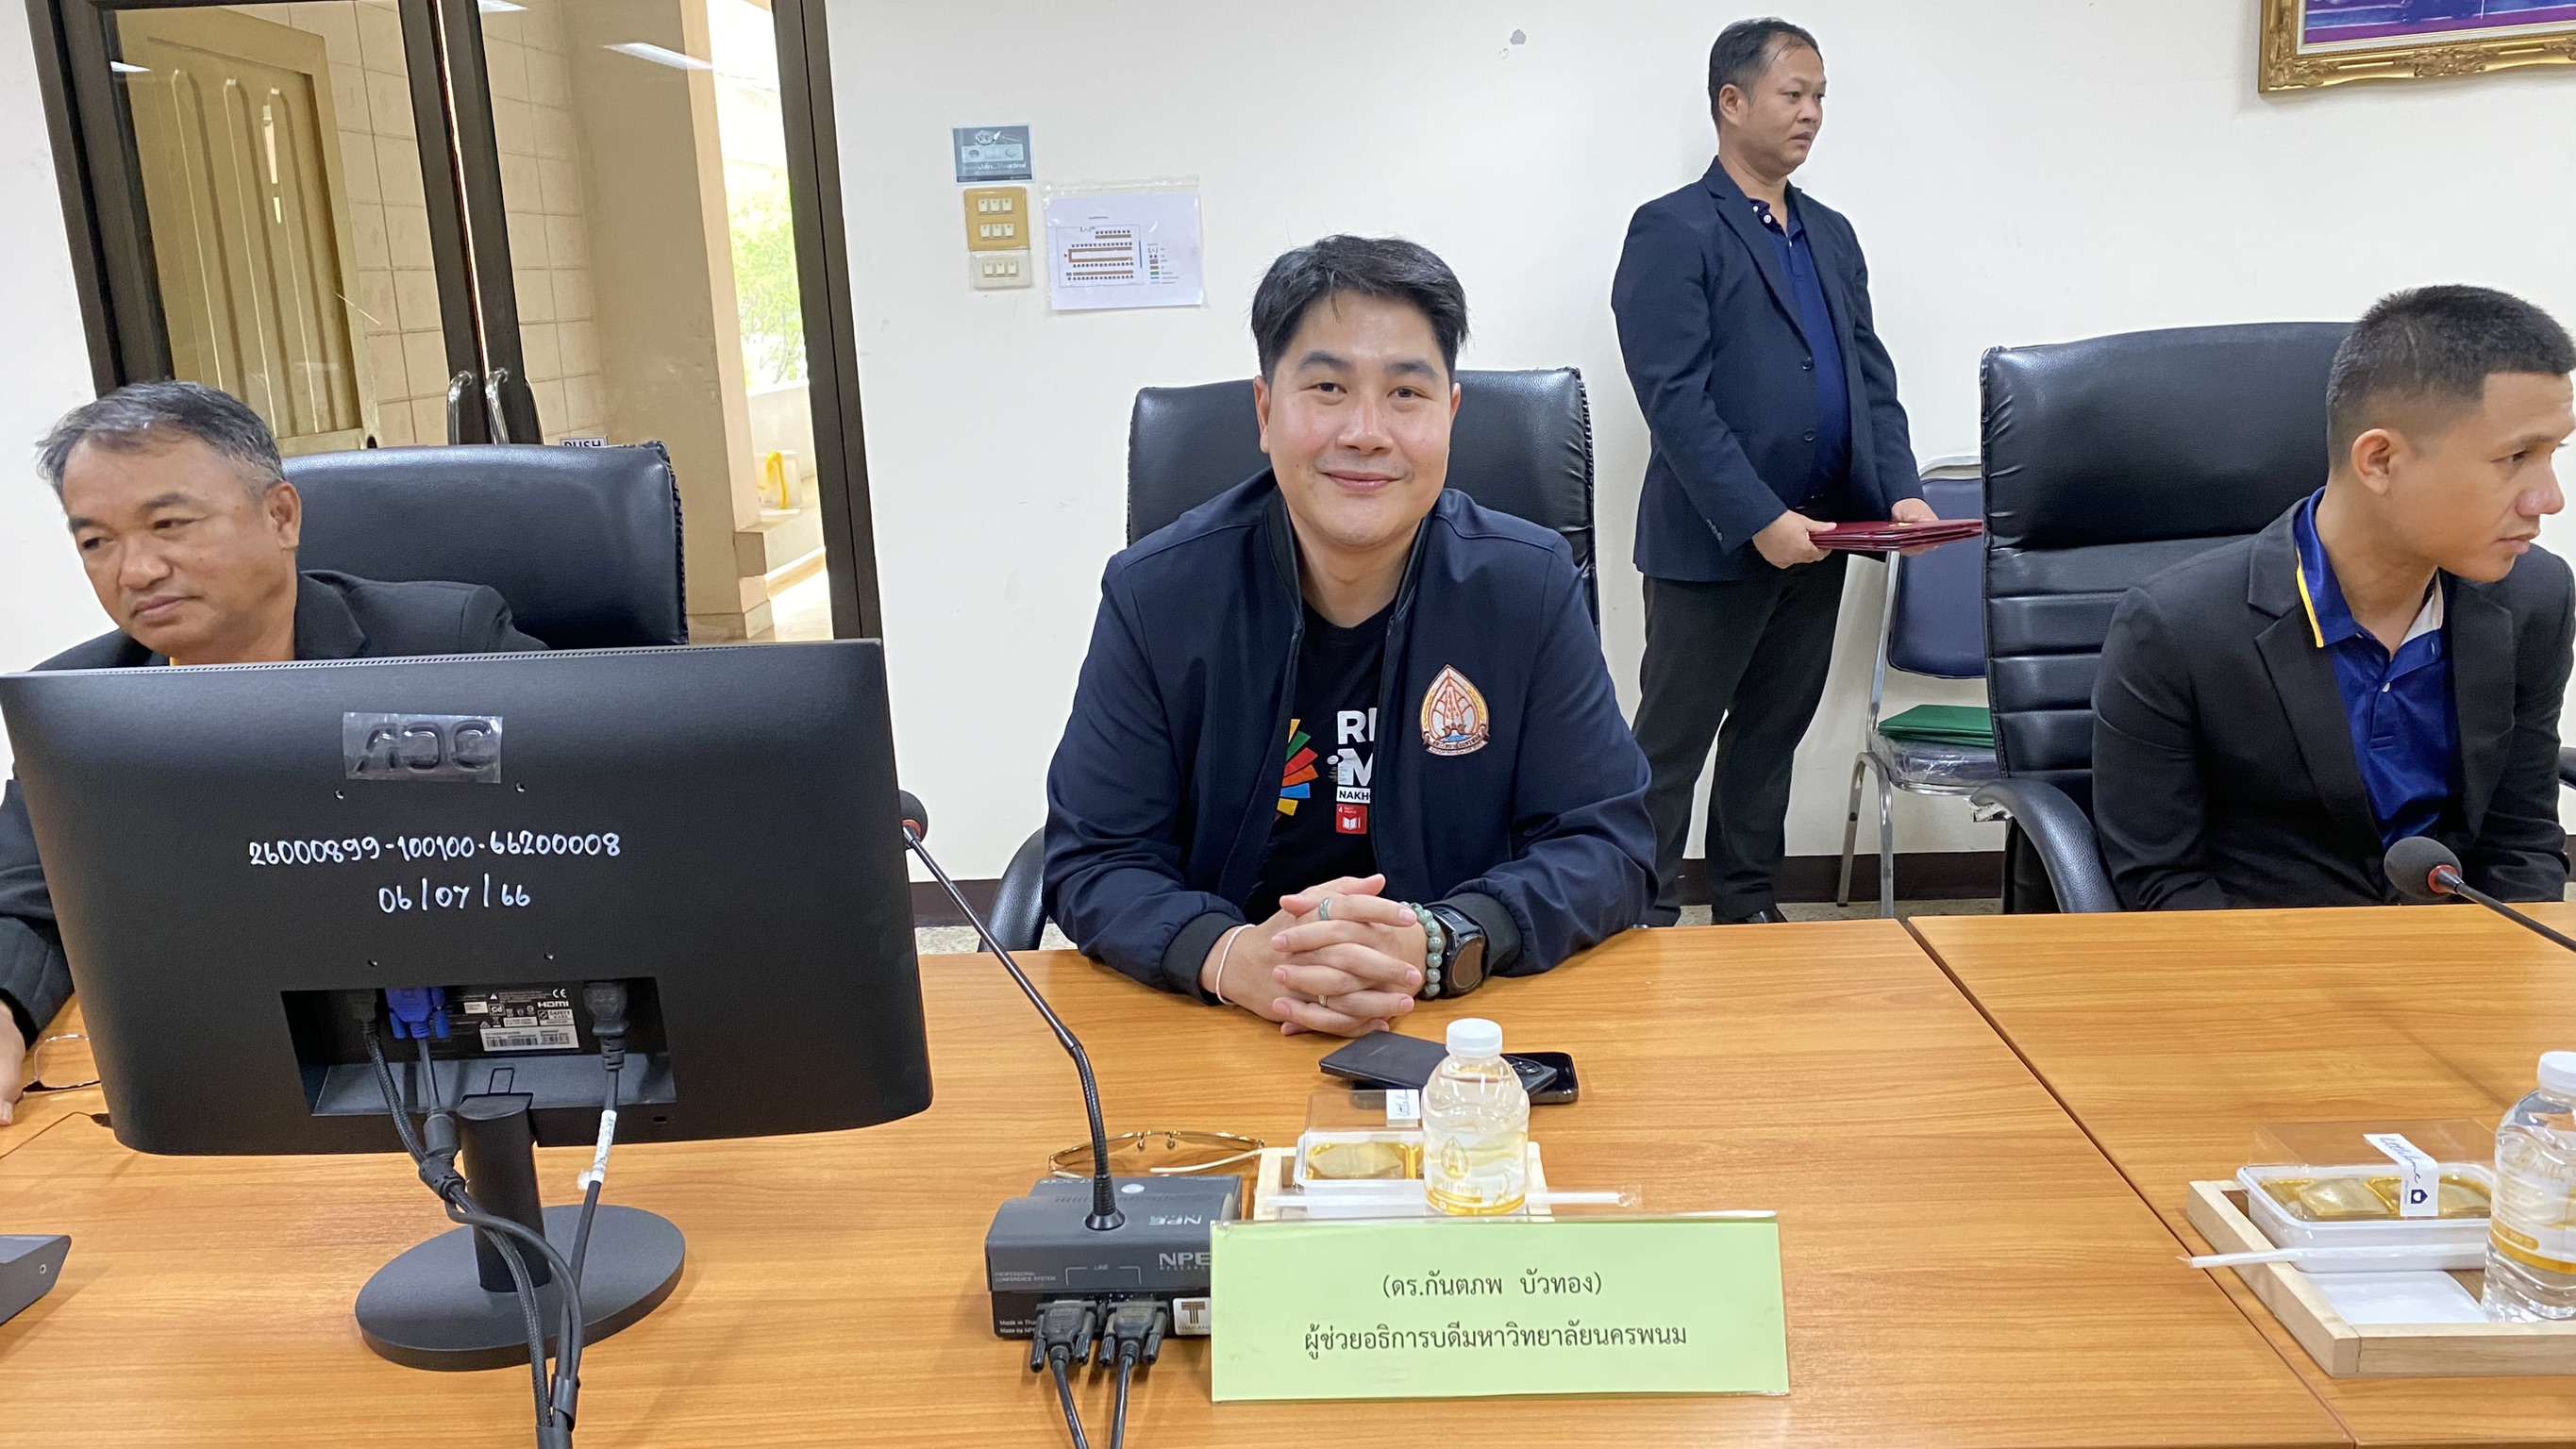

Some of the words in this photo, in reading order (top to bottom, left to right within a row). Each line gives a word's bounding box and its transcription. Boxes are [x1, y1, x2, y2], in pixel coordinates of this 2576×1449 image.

[1338, 790, 1371, 801] NAKH
[1382, 1270, 1503, 1299] (ดร.กันตภพ
[1519, 1268, 1602, 1296] บัวทอง)
[1305, 1319, 1688, 1360] ผู้ช่วยอธิการบดีมหาวิทยาลัยนครพนม
